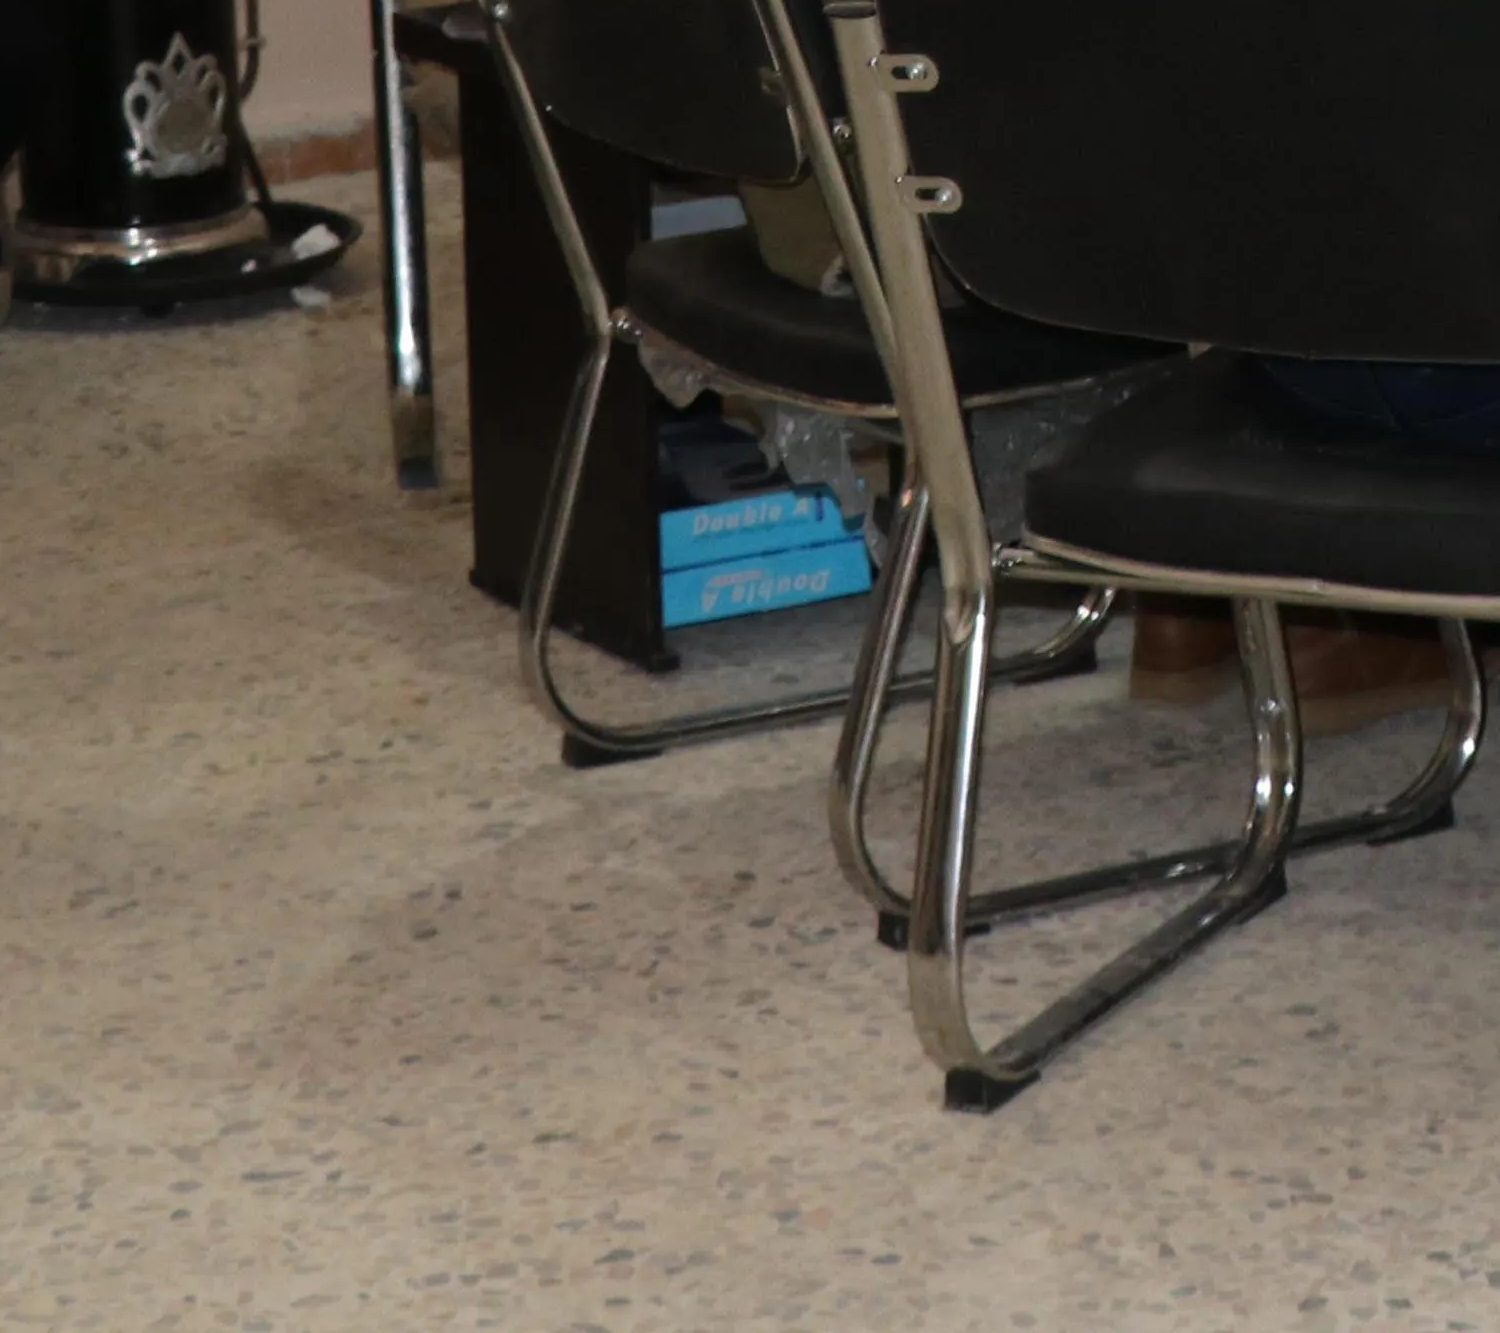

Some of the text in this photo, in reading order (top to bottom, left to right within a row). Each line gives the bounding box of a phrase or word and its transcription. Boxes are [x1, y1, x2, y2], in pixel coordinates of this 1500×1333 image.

[693, 500, 782, 535] Double
[792, 497, 810, 516] A
[702, 587, 721, 613] A
[731, 569, 831, 604] Double
